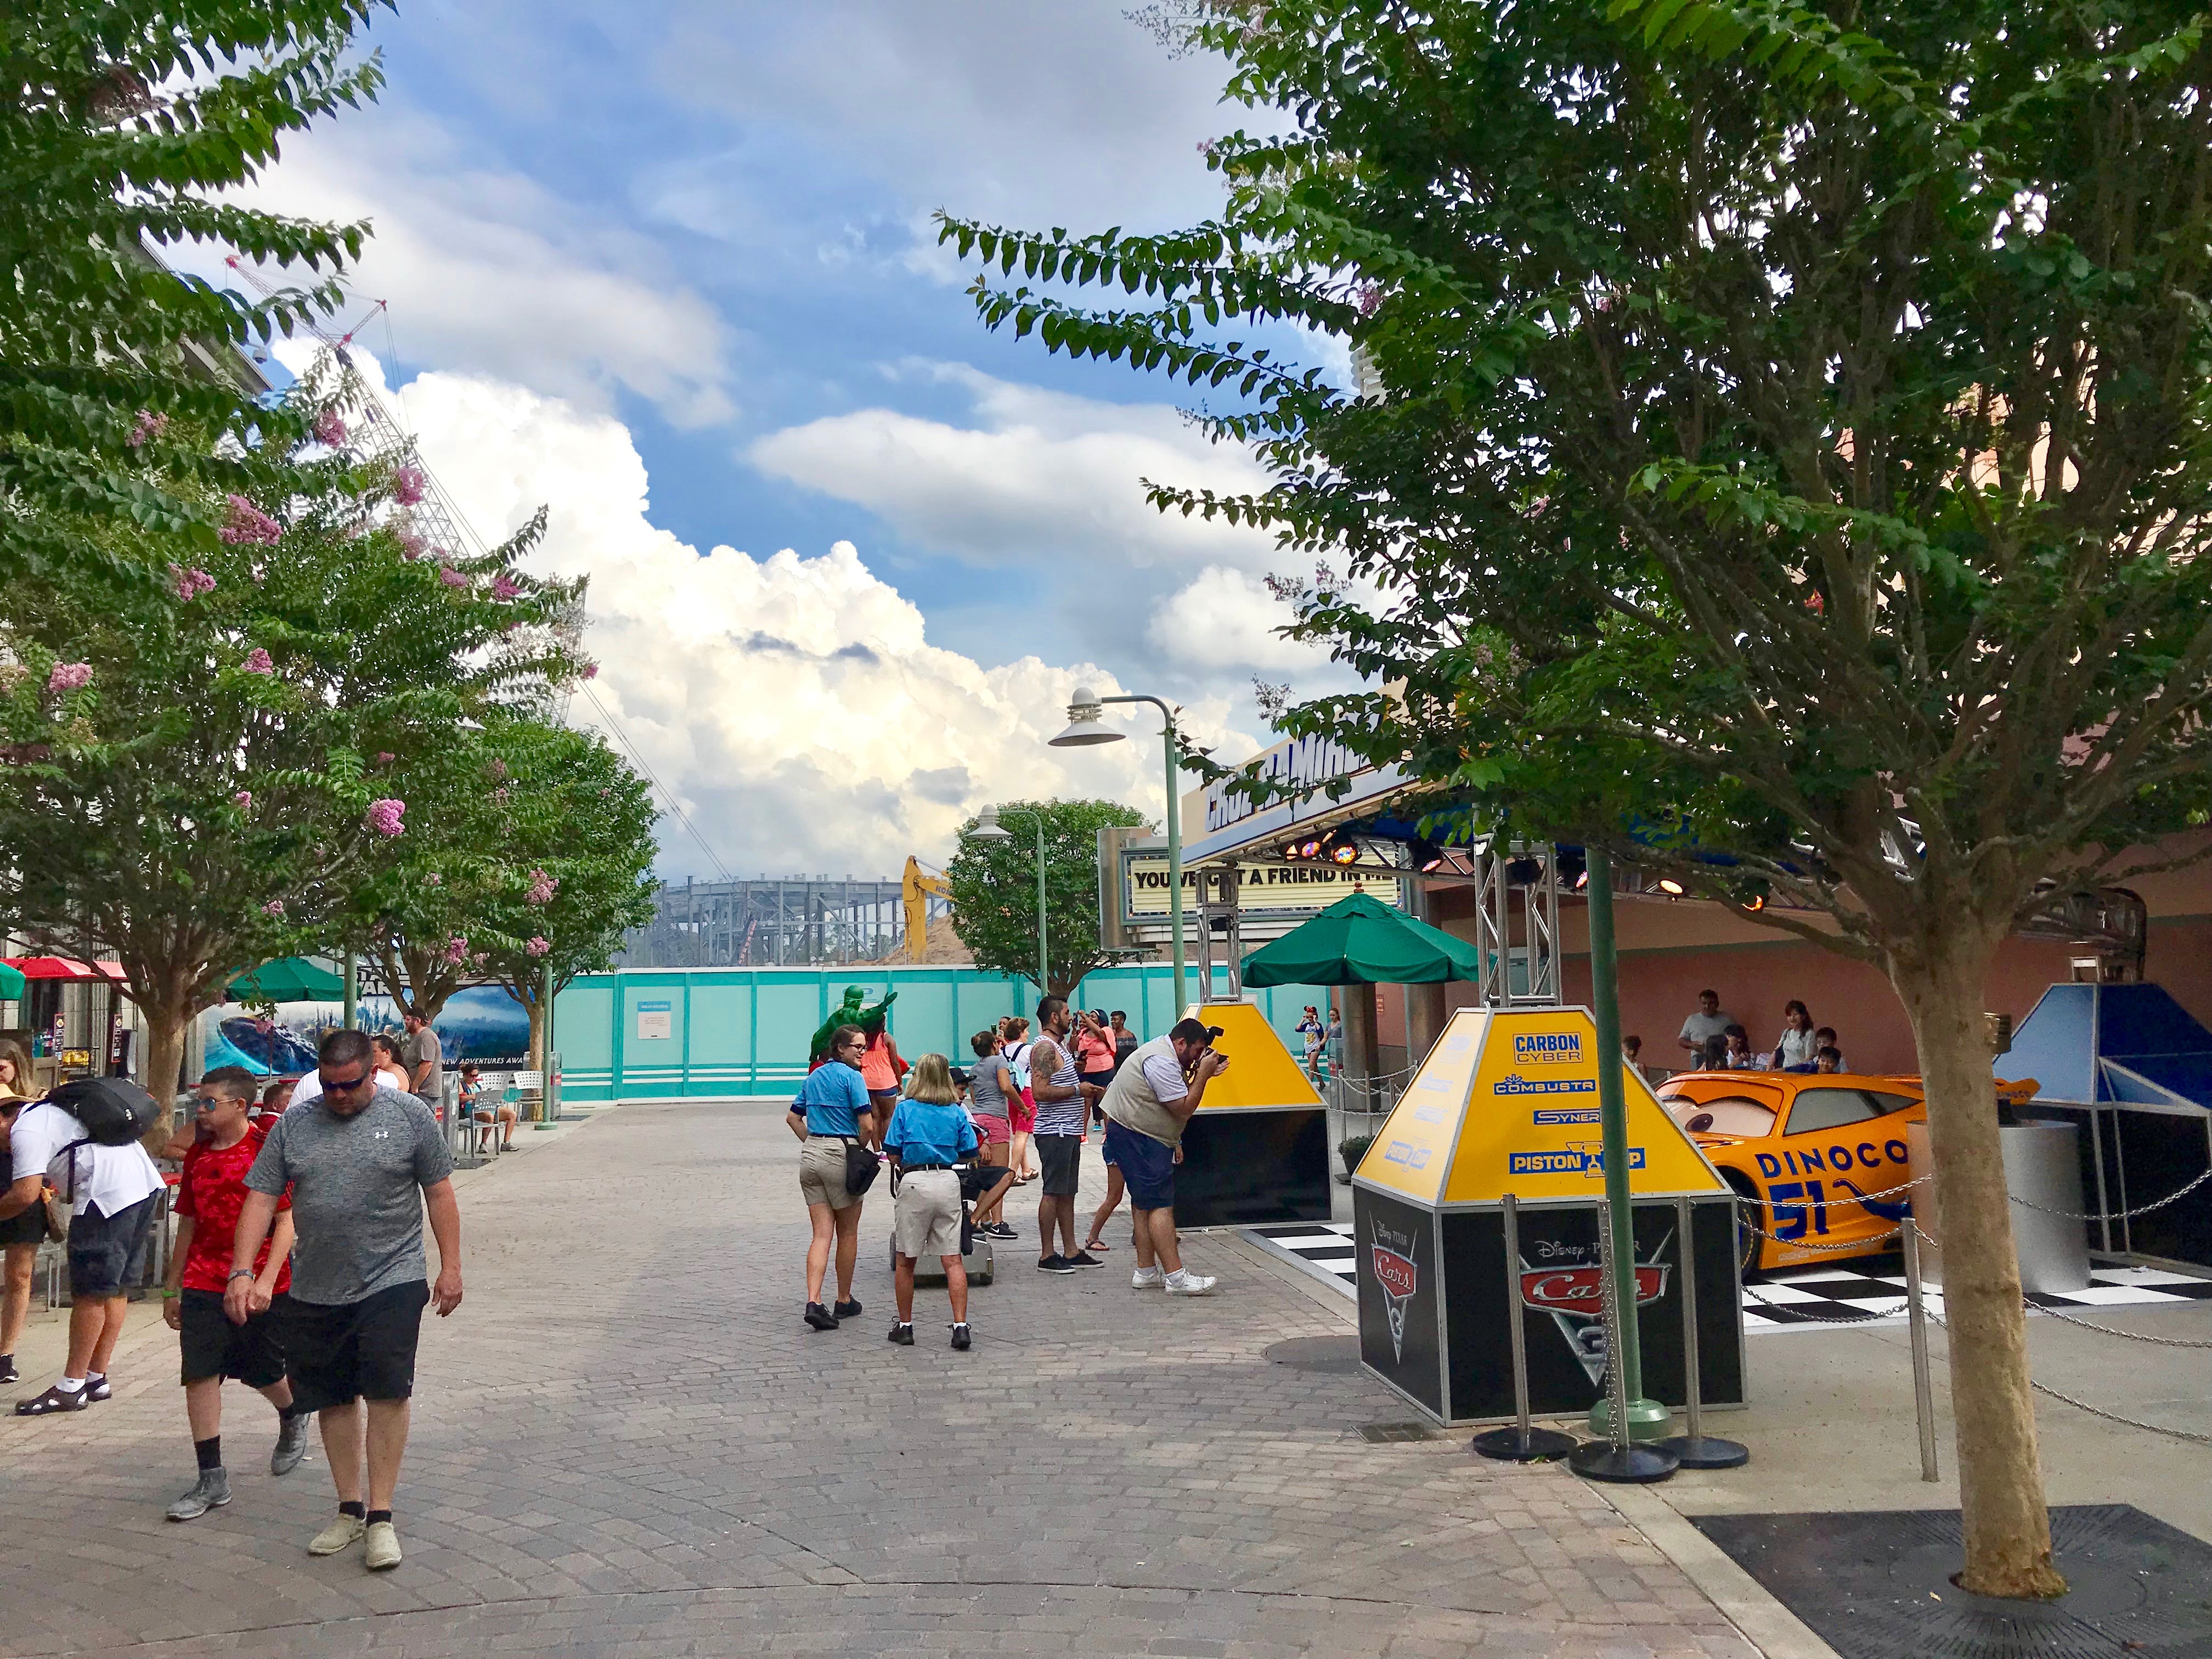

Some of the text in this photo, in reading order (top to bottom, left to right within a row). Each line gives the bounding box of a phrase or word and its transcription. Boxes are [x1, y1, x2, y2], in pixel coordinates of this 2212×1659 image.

[1135, 871, 1197, 888] YOUVE
[1207, 868, 1245, 886] GT
[1249, 869, 1263, 885] A
[1268, 867, 1336, 884] FRIEND
[1341, 870, 1361, 881] IN
[1515, 1034, 1580, 1052] CARBON
[1517, 1052, 1581, 1062] CYBER
[1496, 1081, 1593, 1093] COMBUSTR
[1537, 1108, 1600, 1124] SYNER
[1514, 1154, 1581, 1171] PISTON
[1754, 1139, 1908, 1178] DINOCO
[1768, 1180, 1830, 1242] 51
[1392, 1231, 1407, 1246] PIXAR
[1377, 1255, 1411, 1290] Cars
[1533, 1275, 1647, 1301] Cas
